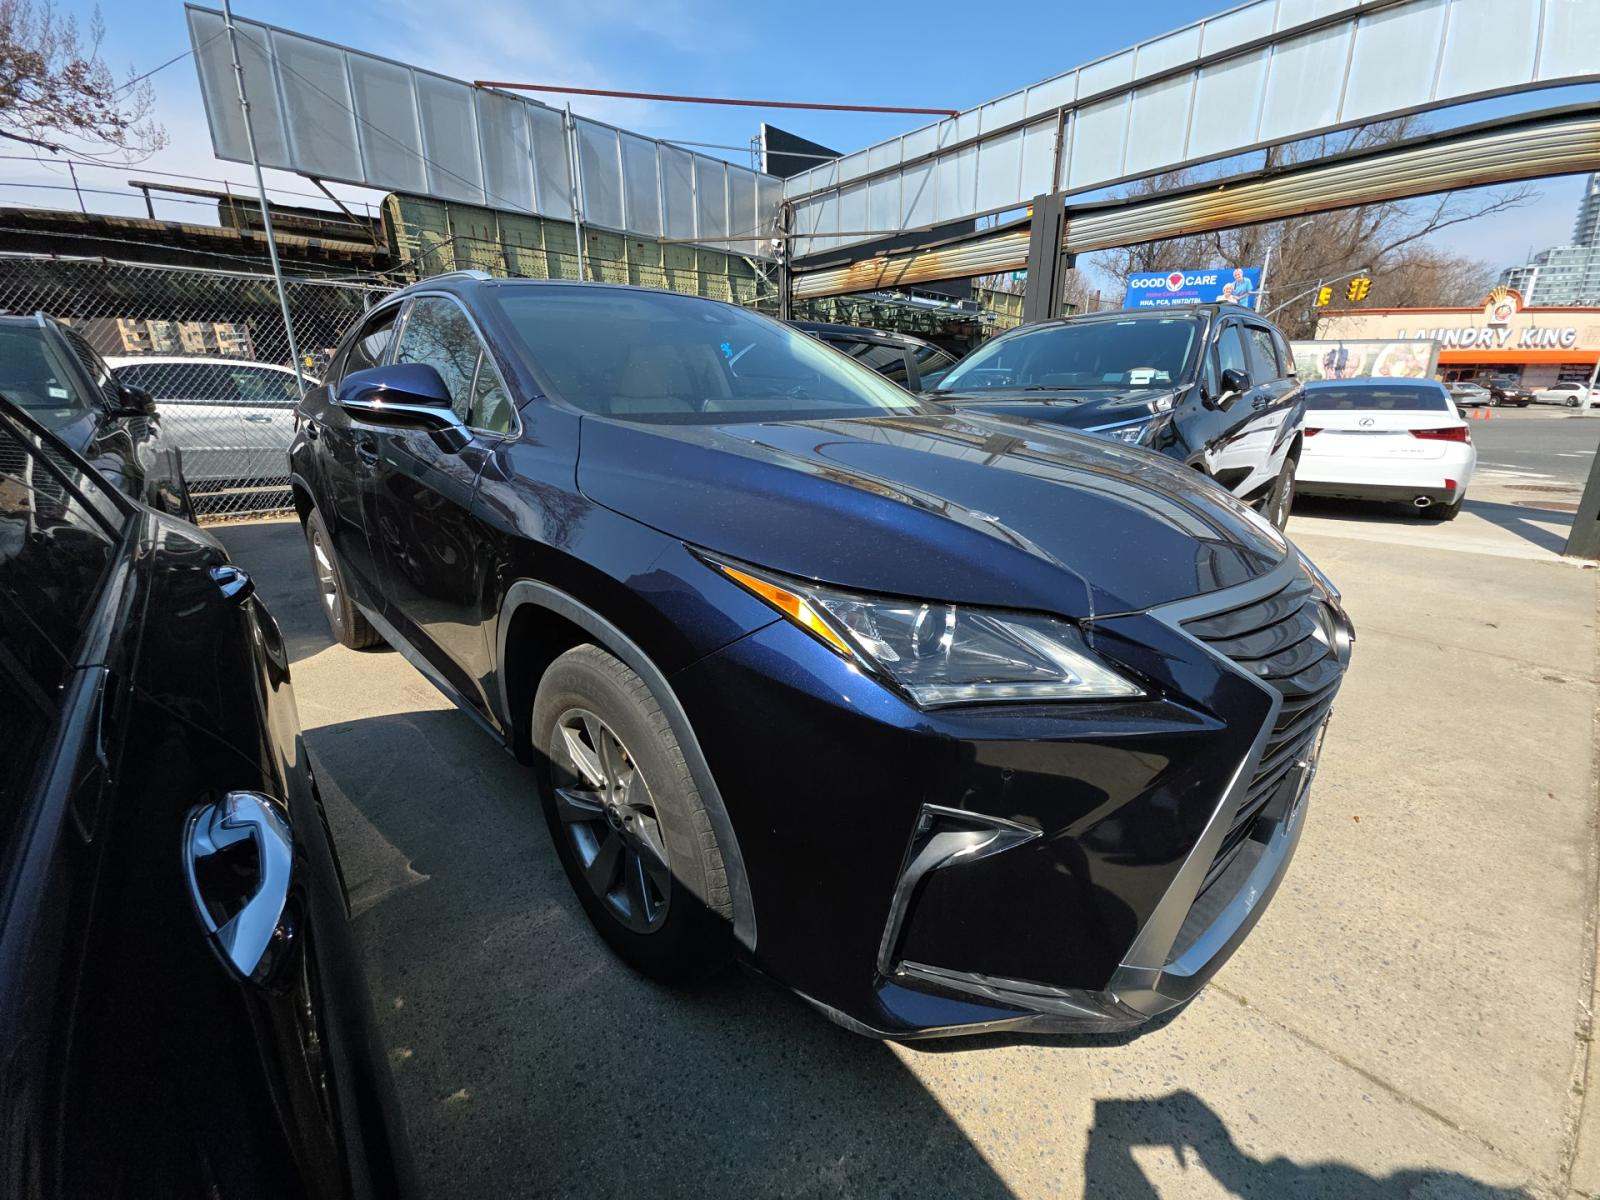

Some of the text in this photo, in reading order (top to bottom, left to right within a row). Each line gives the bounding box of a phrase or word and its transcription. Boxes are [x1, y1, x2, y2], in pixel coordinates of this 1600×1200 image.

[1131, 275, 1217, 288] GOOD CARE
[1518, 328, 1577, 348] KING
